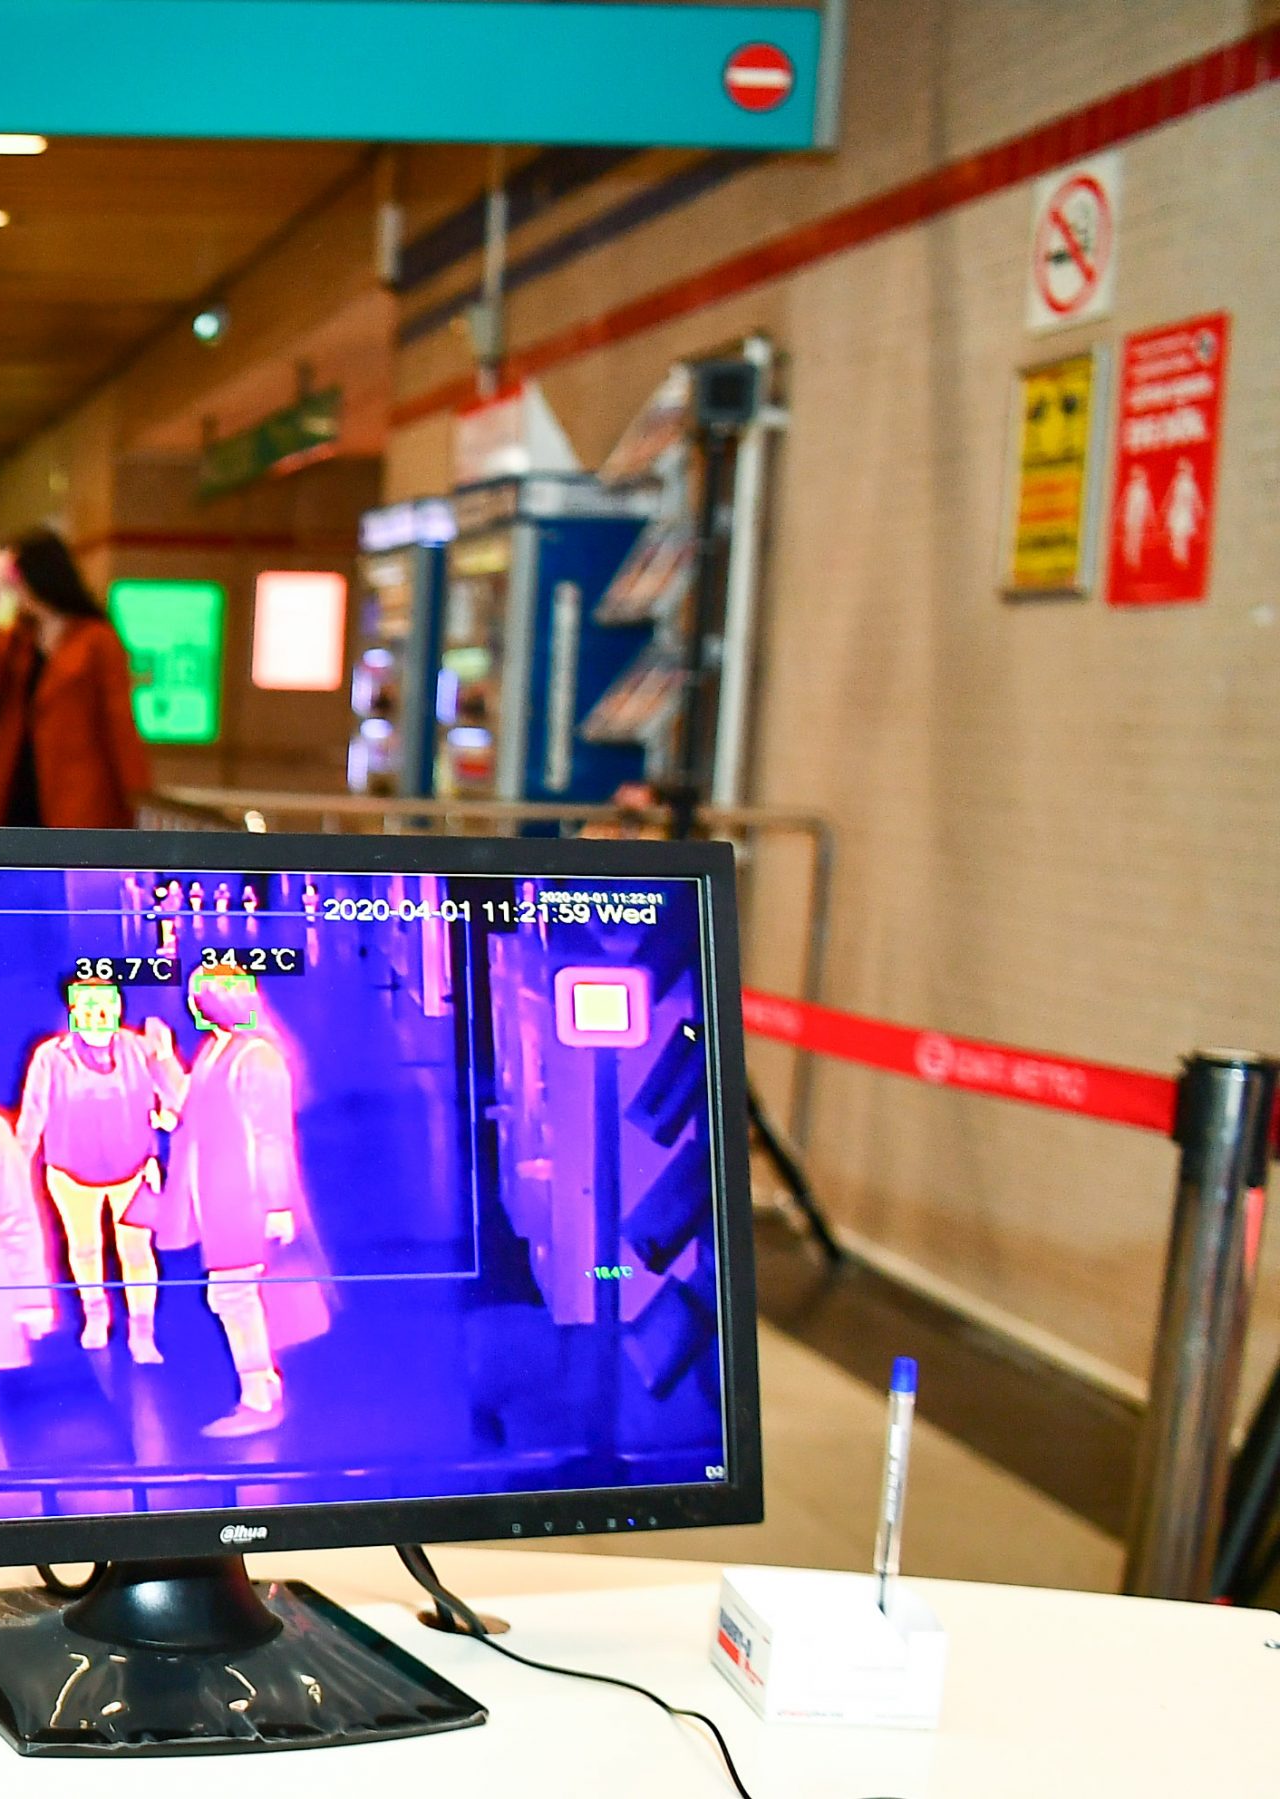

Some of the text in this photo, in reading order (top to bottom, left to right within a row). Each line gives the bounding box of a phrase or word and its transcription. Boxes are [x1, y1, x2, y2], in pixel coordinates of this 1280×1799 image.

[539, 891, 608, 904] 2020-04-01
[323, 898, 657, 925] 2020-04-01 11:21:59 Wed
